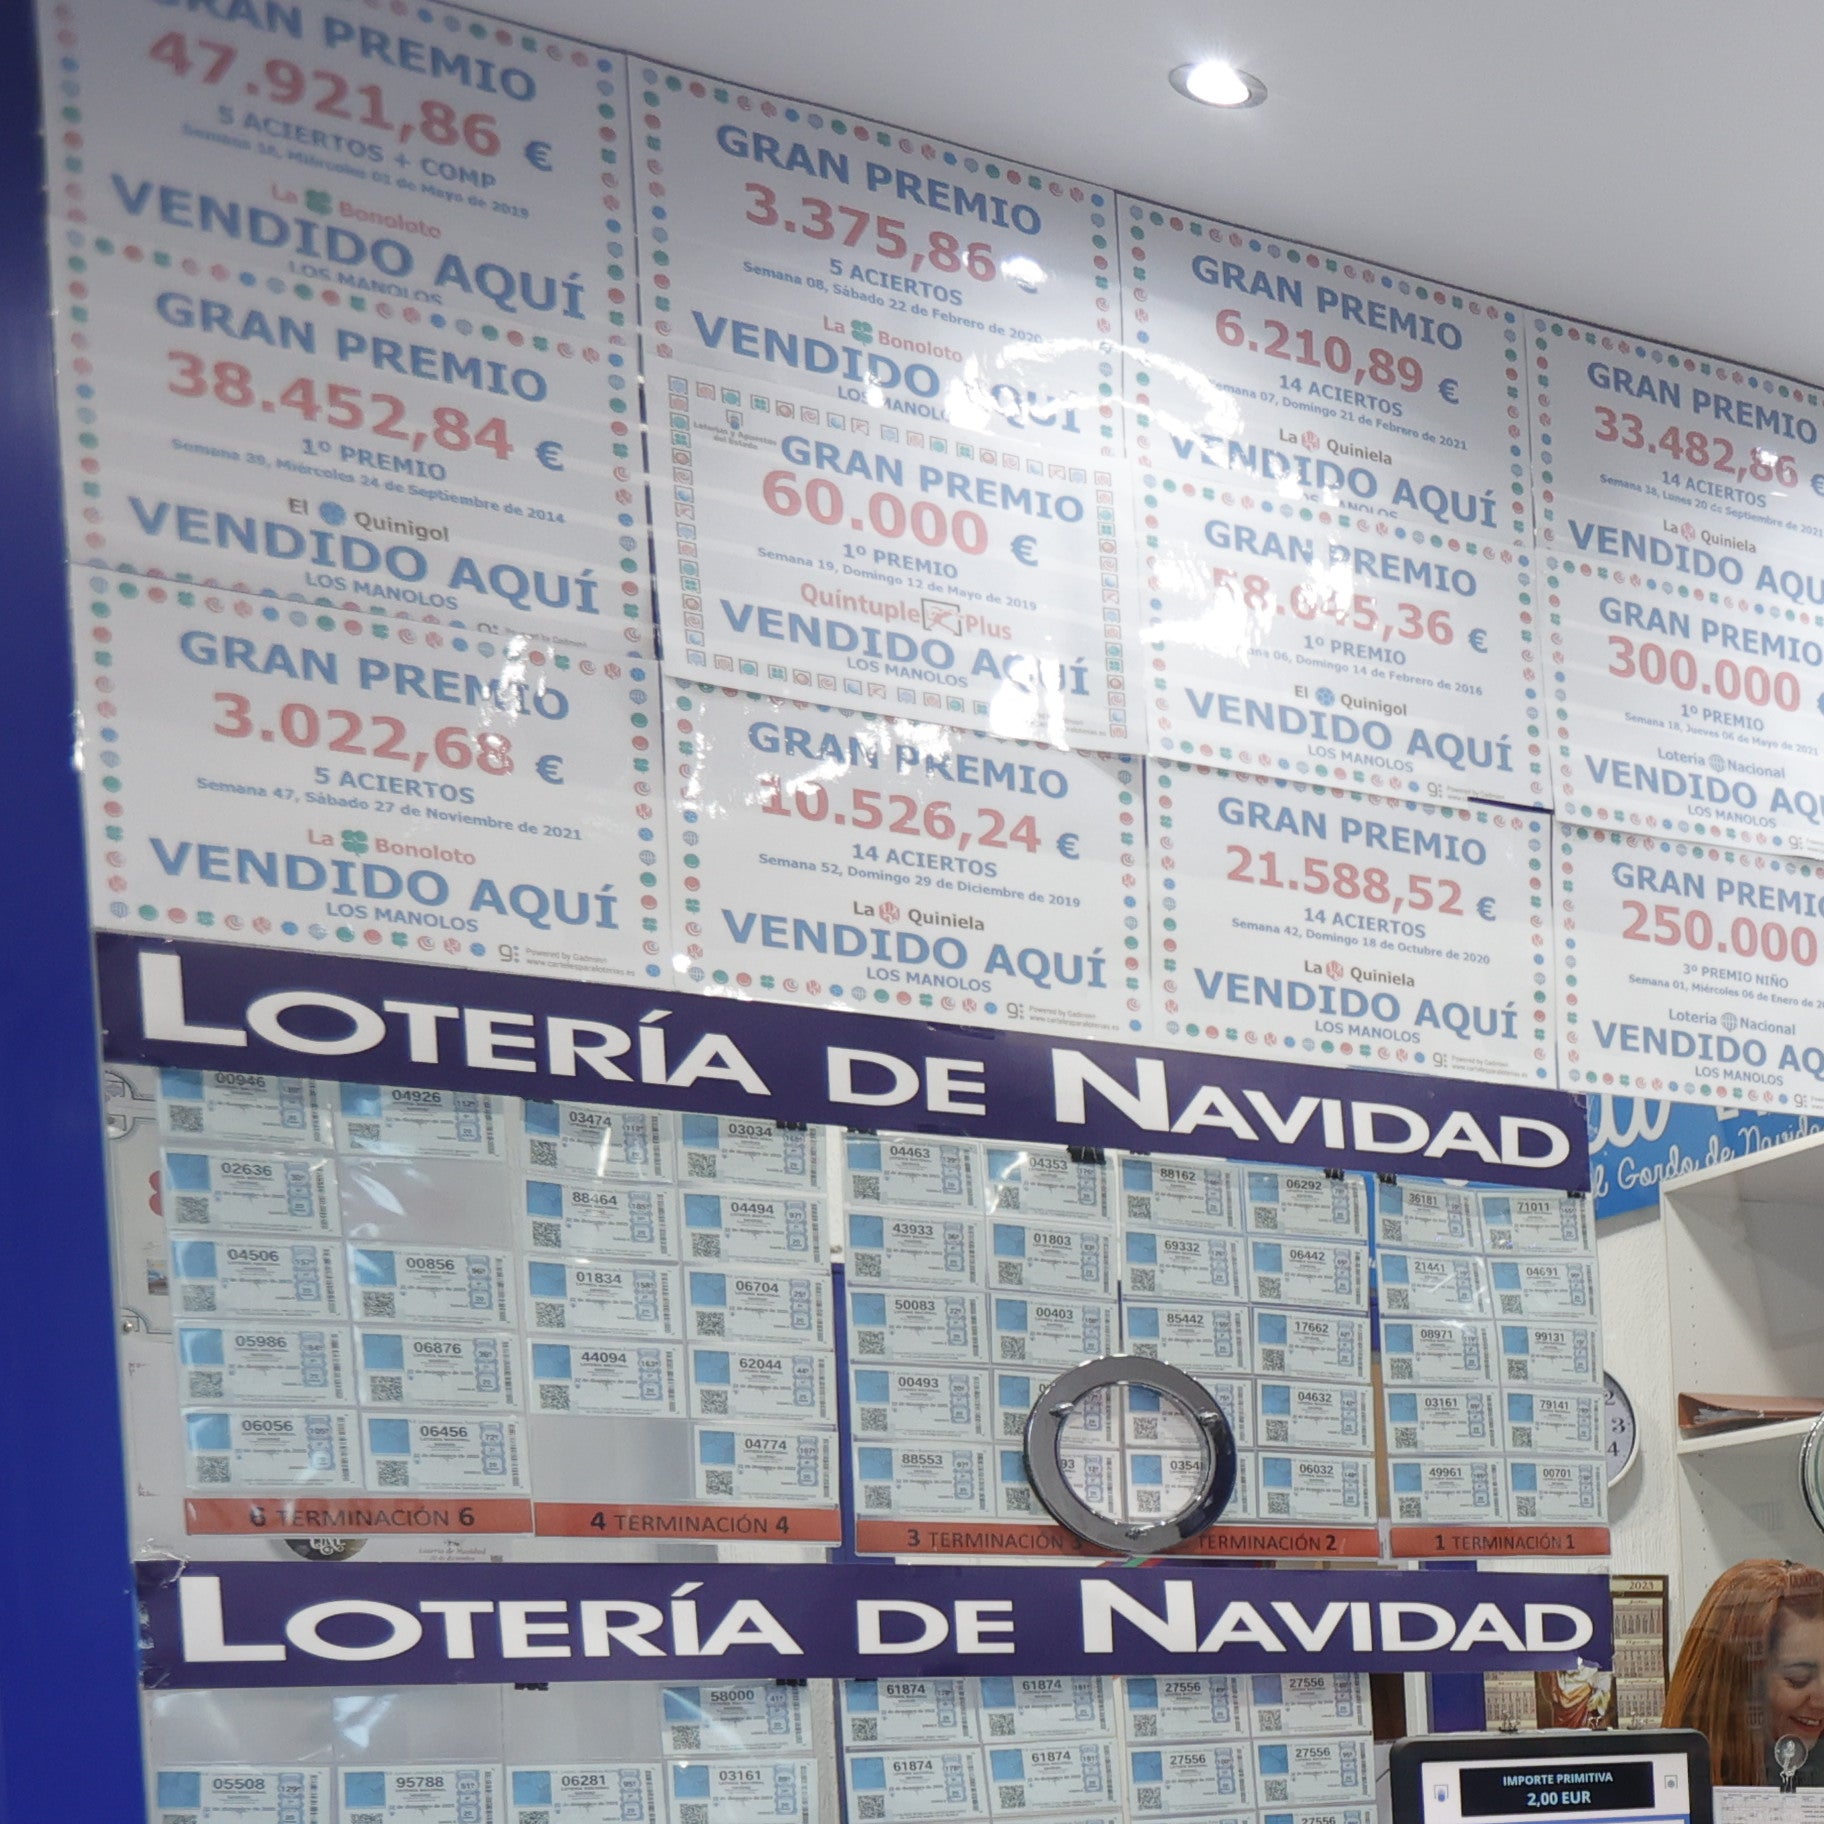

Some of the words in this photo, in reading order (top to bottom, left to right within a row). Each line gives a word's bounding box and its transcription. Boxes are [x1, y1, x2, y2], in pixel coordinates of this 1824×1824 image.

[148, 30, 503, 160] 47.921,86
[717, 124, 850, 186] GRAN
[866, 161, 1042, 236] PREMIO
[113, 174, 414, 278] VENDIDO
[436, 250, 586, 322] AQUÍ
[744, 181, 997, 283] 3.375,86
[156, 292, 314, 354] GRAN
[337, 329, 548, 402] PREMIO
[1215, 308, 1424, 393] 6.210,89
[166, 350, 515, 461] 38.452,84
[1594, 405, 1799, 488] 33.482,86
[762, 468, 989, 556] 60.000
[965, 615, 1012, 642] Plus
[180, 630, 338, 684] GRAN
[359, 656, 569, 721] PREMIO
[1607, 635, 1800, 712] 300.000
[213, 692, 516, 774] 3.022,68
[308, 828, 334, 849] La
[375, 836, 477, 866] Bonoloto
[149, 836, 449, 904] VENDIDO
[470, 884, 619, 931] AQUÍ
[1226, 844, 1464, 916] 21.588,52
[326, 901, 366, 921] LOS
[373, 905, 478, 932] MANOLOS
[853, 900, 875, 919] La
[907, 909, 985, 932] Quiniela
[1304, 907, 1326, 925] 14
[1331, 912, 1427, 939] ACIERTOS
[1621, 900, 1818, 968] 250.000
[1194, 967, 1400, 1023] VENDIDO
[1414, 1001, 1518, 1041] AQUÍ
[138, 951, 772, 1097] LOTERÍA
[826, 1046, 988, 1116] DE
[1051, 1048, 1570, 1170] NAVIDAD
[220, 1160, 273, 1180] 02636
[1617, 1145, 1701, 1190] Gordo
[730, 1200, 775, 1216] 04494
[227, 1247, 280, 1265] 04506
[234, 1333, 288, 1351] 05986
[412, 1339, 462, 1356] 06876
[739, 1357, 783, 1373] 62044
[1611, 1417, 1626, 1433] 3
[1606, 1442, 1620, 1457] 4
[249, 1507, 266, 1527] 6
[276, 1503, 451, 1528] TERMINACIÓN
[458, 1507, 476, 1527] 6
[590, 1511, 607, 1531] 4
[613, 1508, 771, 1536] TERMINACIÓN
[776, 1514, 791, 1534] 4
[906, 1530, 920, 1548] 3
[928, 1528, 1064, 1552] TERMINACIÓN
[1325, 1532, 1338, 1551] 2
[1435, 1534, 1445, 1551] 1
[1450, 1530, 1562, 1552] TERMINACIÓN
[1565, 1533, 1575, 1549] 1
[180, 1575, 803, 1663] LOTERÍA
[856, 1600, 1015, 1656] DE
[1081, 1579, 1594, 1654] NAVIDAD
[1503, 1774, 1554, 1787] IMPORTE
[1556, 1771, 1613, 1785] PRIMITIVA
[1527, 1792, 1559, 1806] 2,00
[1561, 1791, 1591, 1805] EUR
